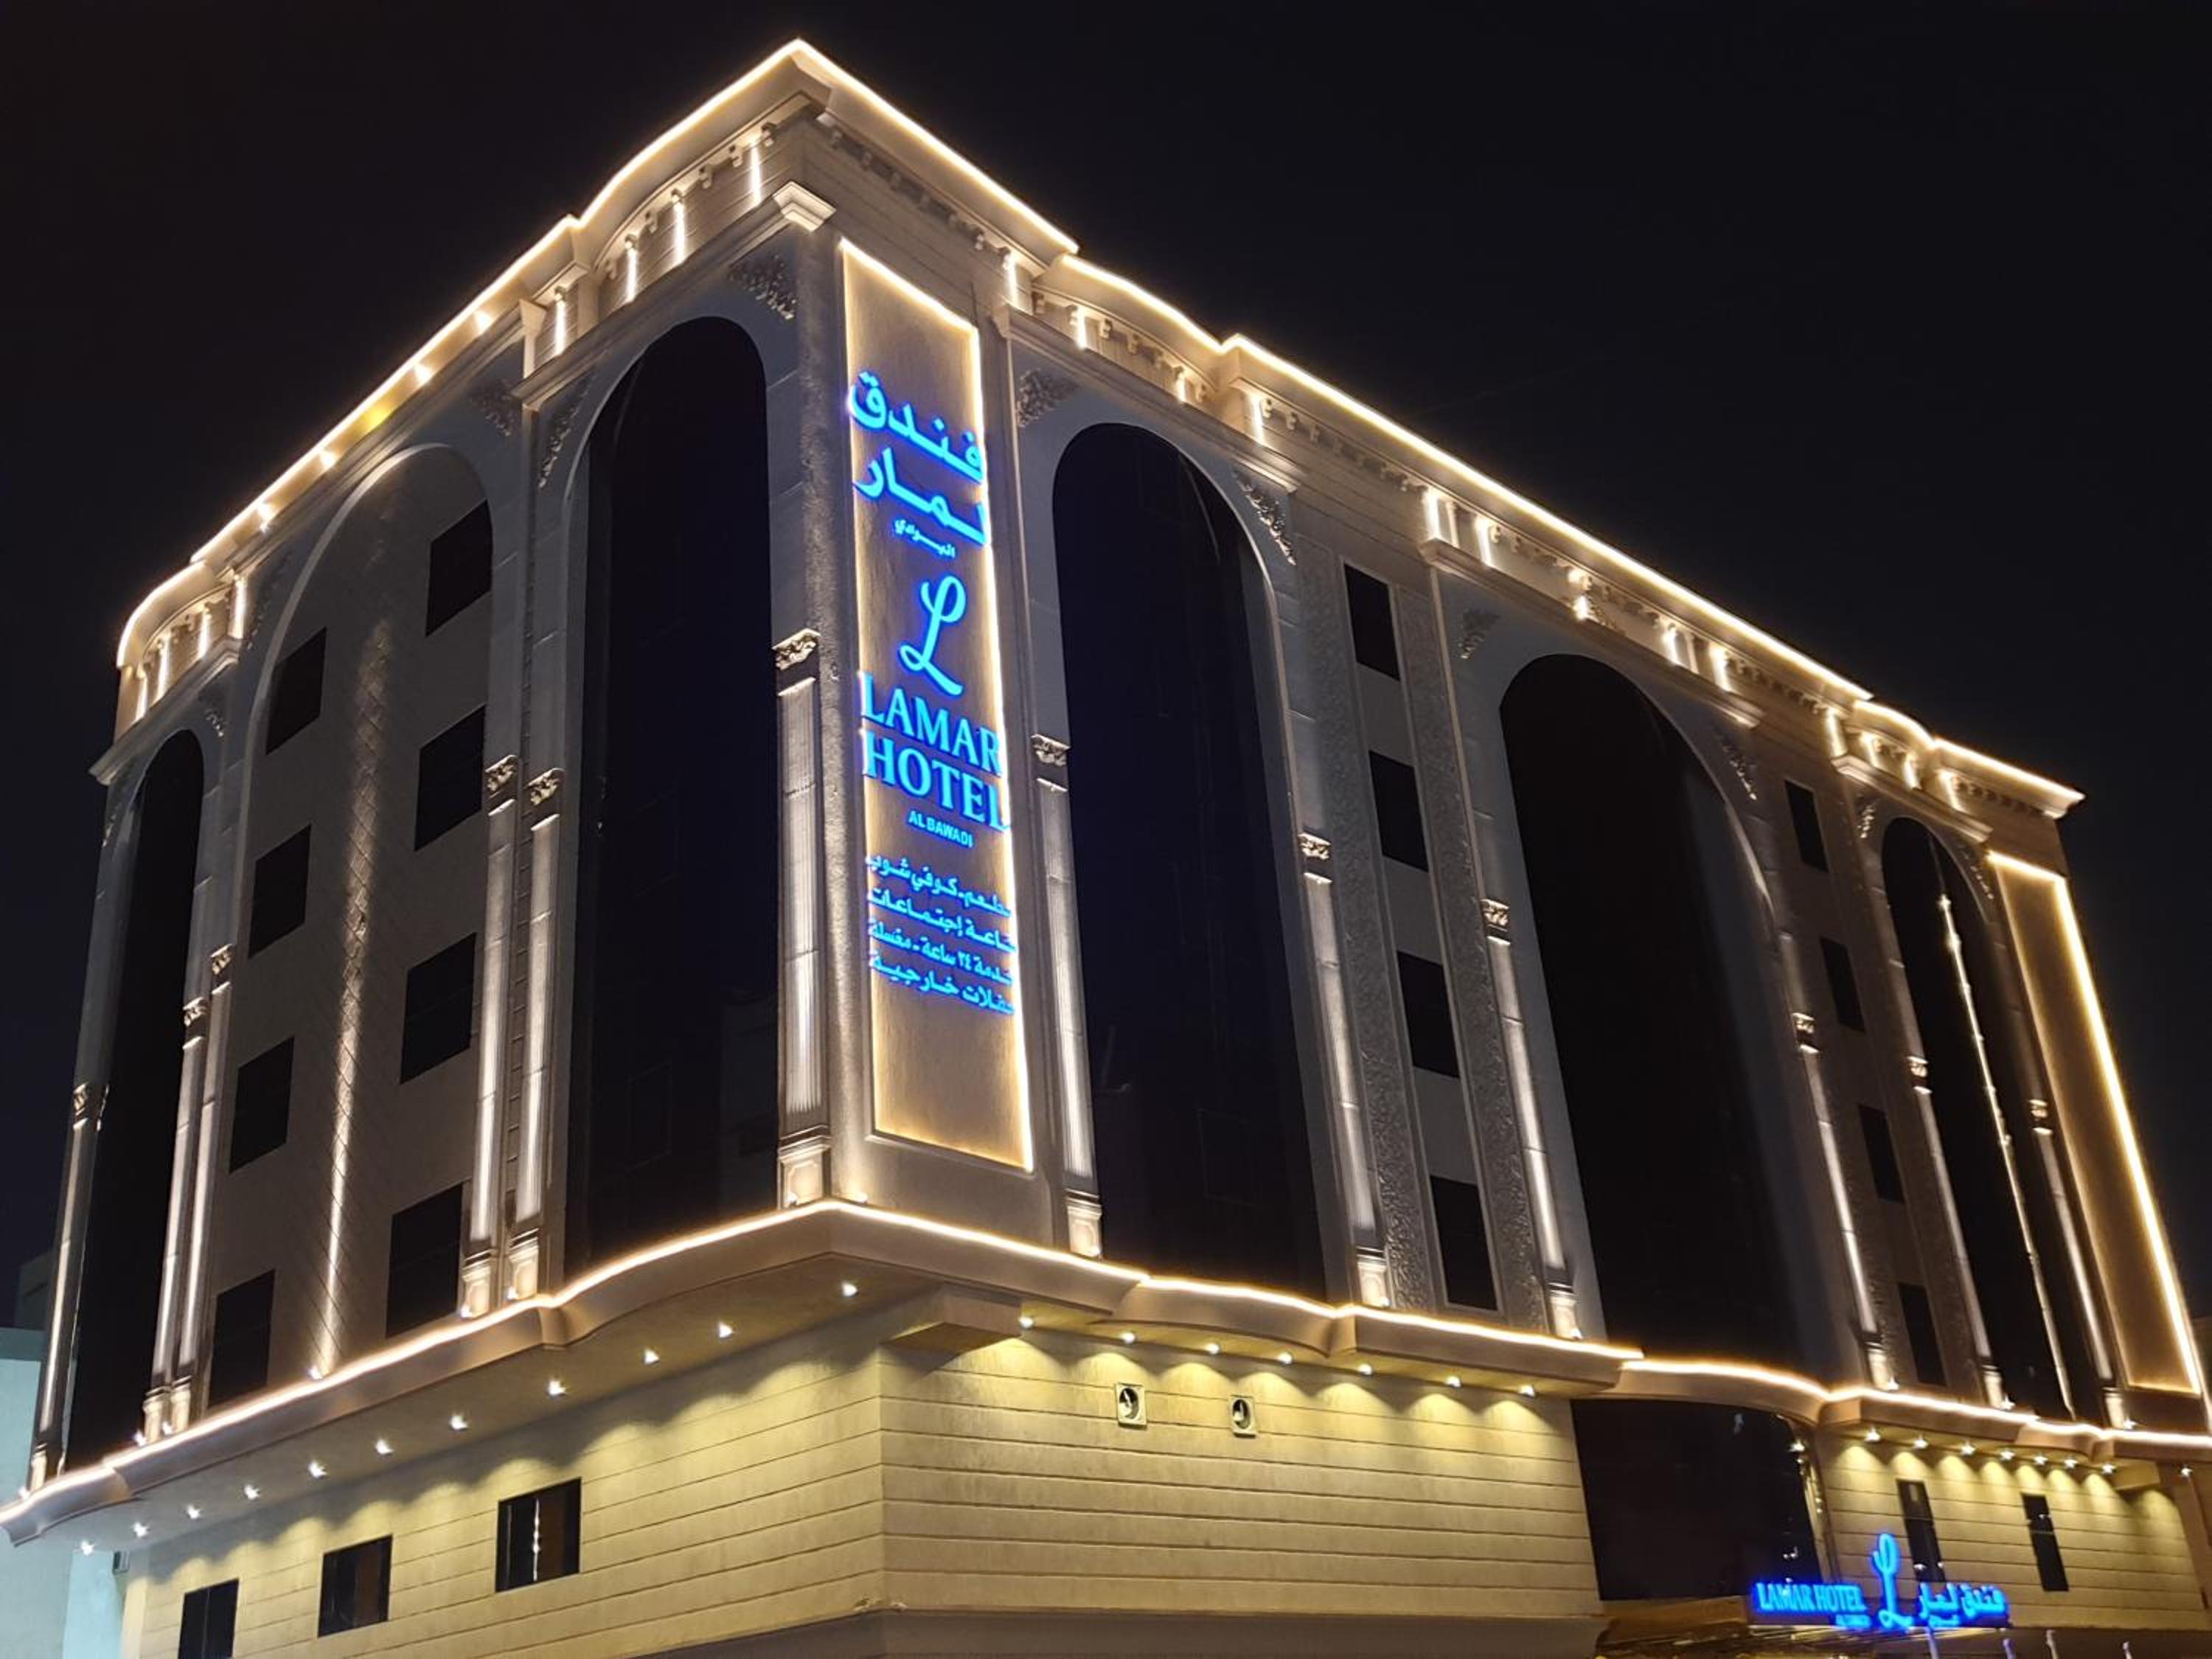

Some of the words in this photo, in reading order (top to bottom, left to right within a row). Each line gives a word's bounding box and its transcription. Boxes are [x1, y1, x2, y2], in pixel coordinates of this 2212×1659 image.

[847, 370, 985, 485] فندق
[853, 447, 990, 546] لمار
[858, 672, 1002, 777] LAMAR
[860, 728, 1009, 831] HOTEL
[908, 810, 926, 828] AL
[927, 817, 973, 848] BAWADI
[965, 890, 1012, 917] طعم
[921, 936, 956, 965] ساعة
[1756, 1582, 1817, 1612] LAMAR
[1813, 1585, 1866, 1613] HOTEL
[1919, 1582, 1959, 1619] لمار
[1961, 1583, 2006, 1619] فندق
